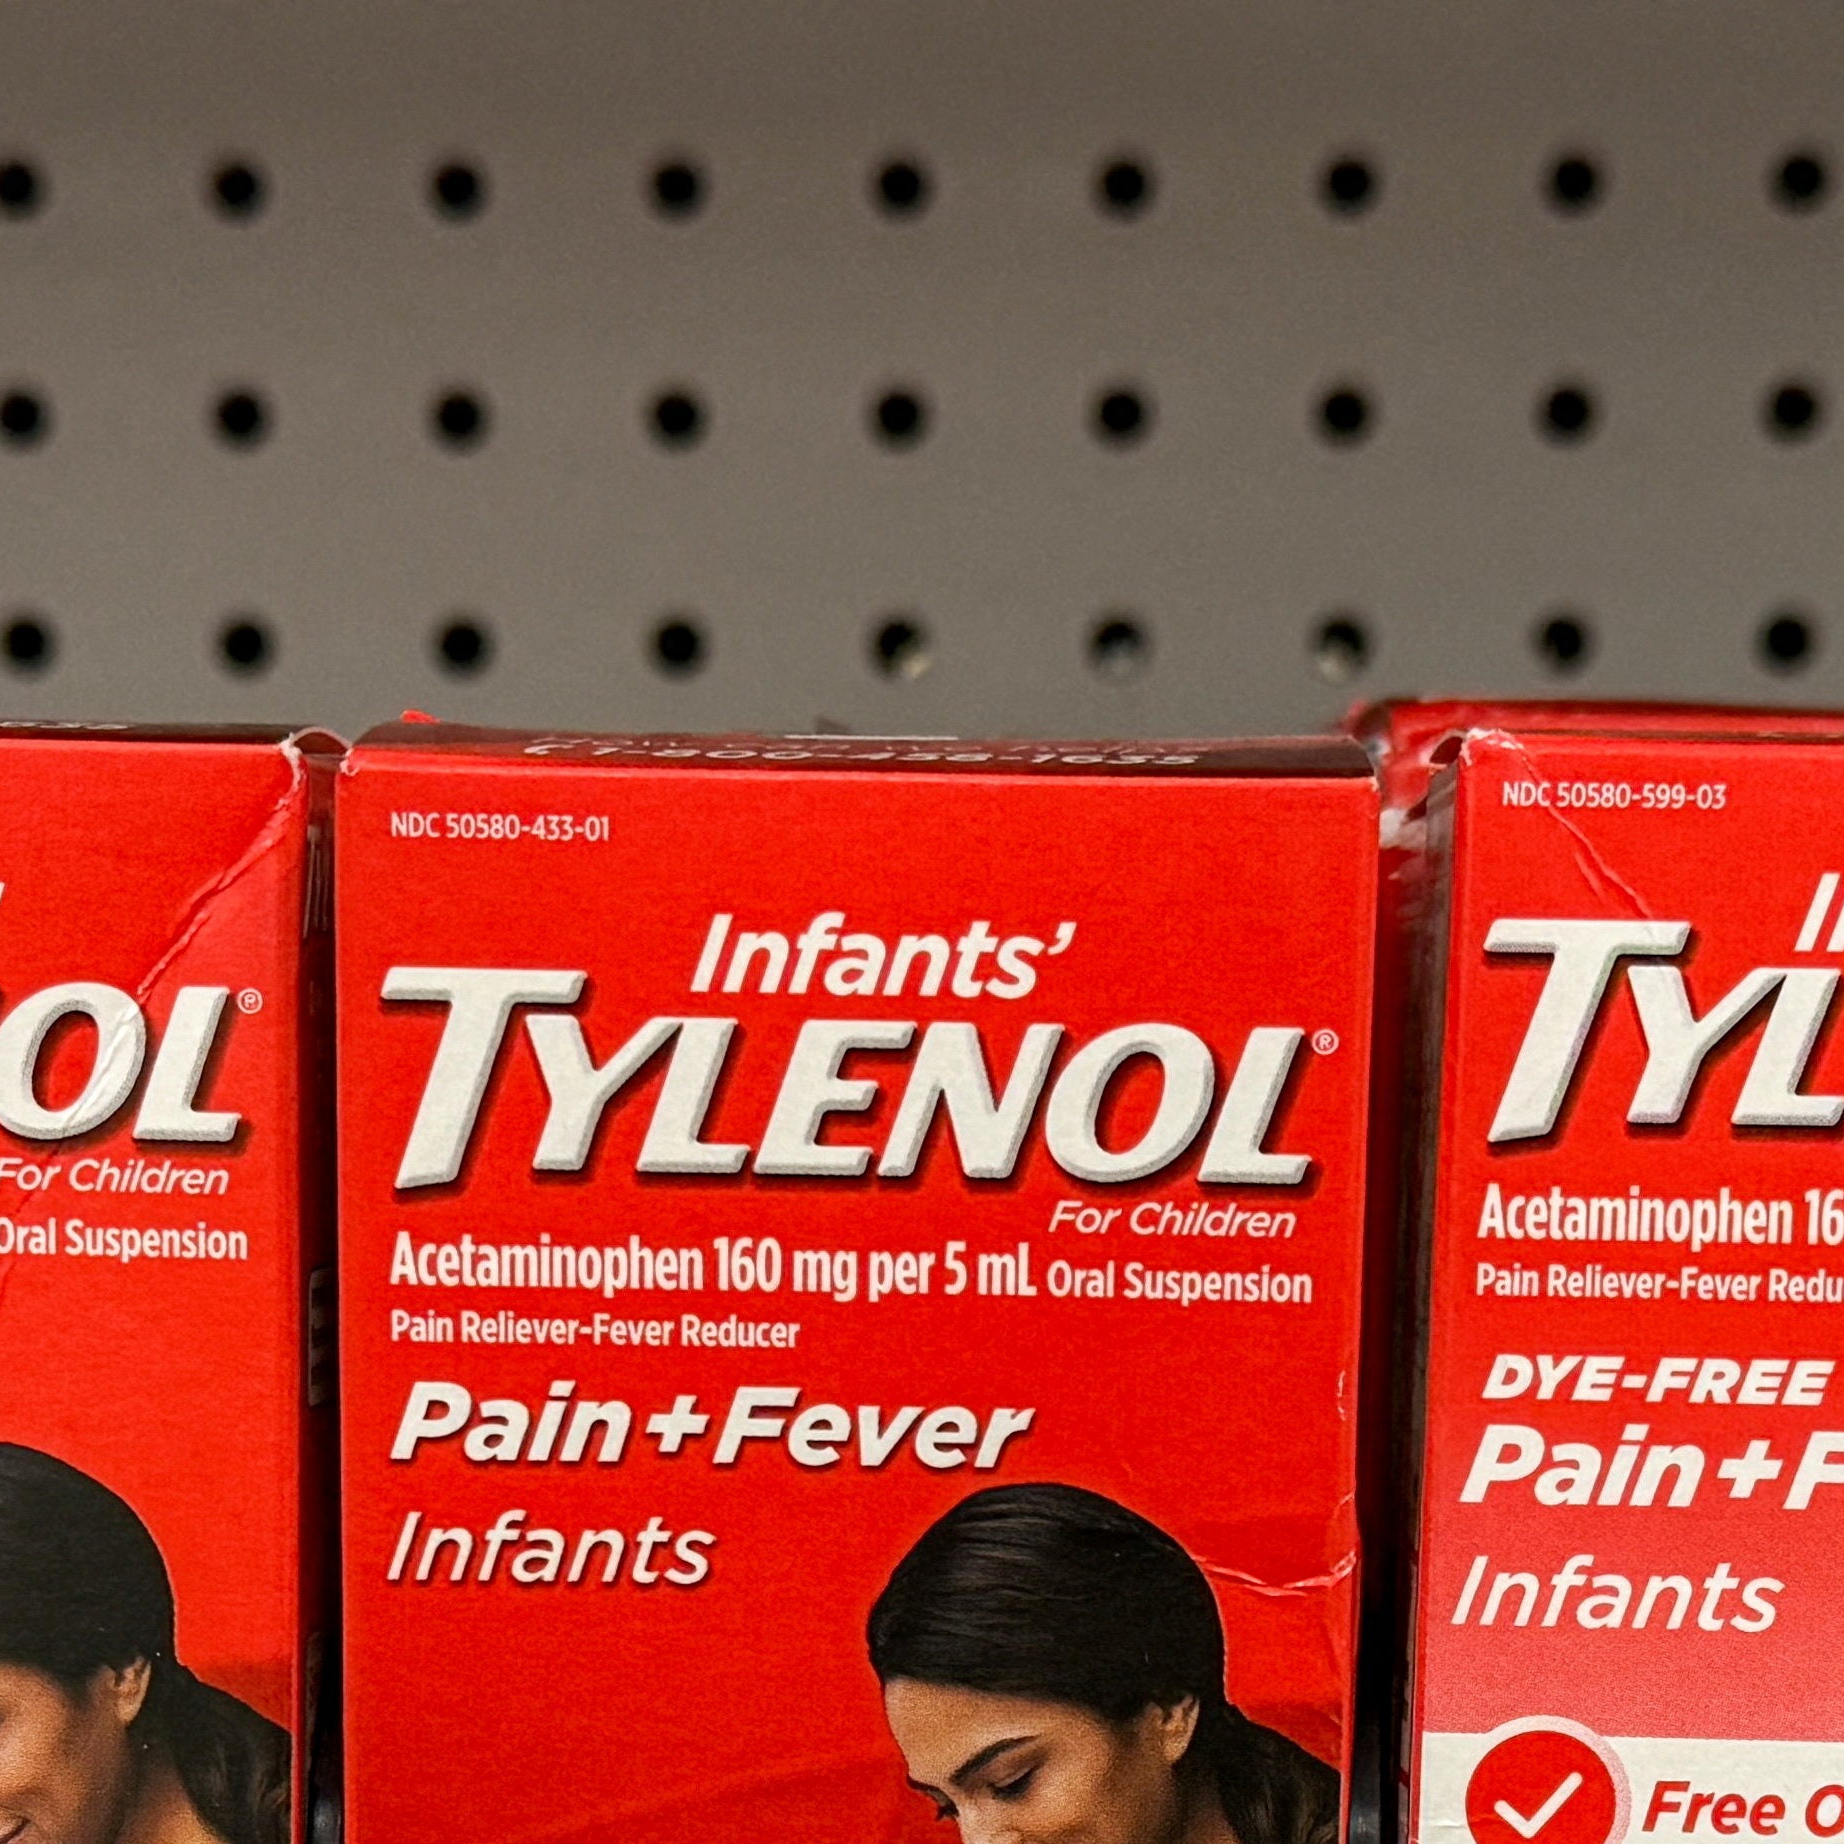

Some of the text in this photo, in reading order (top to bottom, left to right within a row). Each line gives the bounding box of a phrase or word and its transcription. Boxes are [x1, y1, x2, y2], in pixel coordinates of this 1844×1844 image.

[1503, 781, 1725, 809] NDC 50580-599-03
[391, 812, 609, 841] NDC 50580-433-01
[389, 1230, 1037, 1303] Acetaminophen 160 mg per 5 mL
[1048, 1259, 1313, 1306] Oral Suspension
[1482, 1353, 1835, 1407] DYE-FREE
[387, 1508, 716, 1585] Infants
[1451, 1554, 1785, 1634] Infants
[1640, 1780, 1786, 1838] Free
